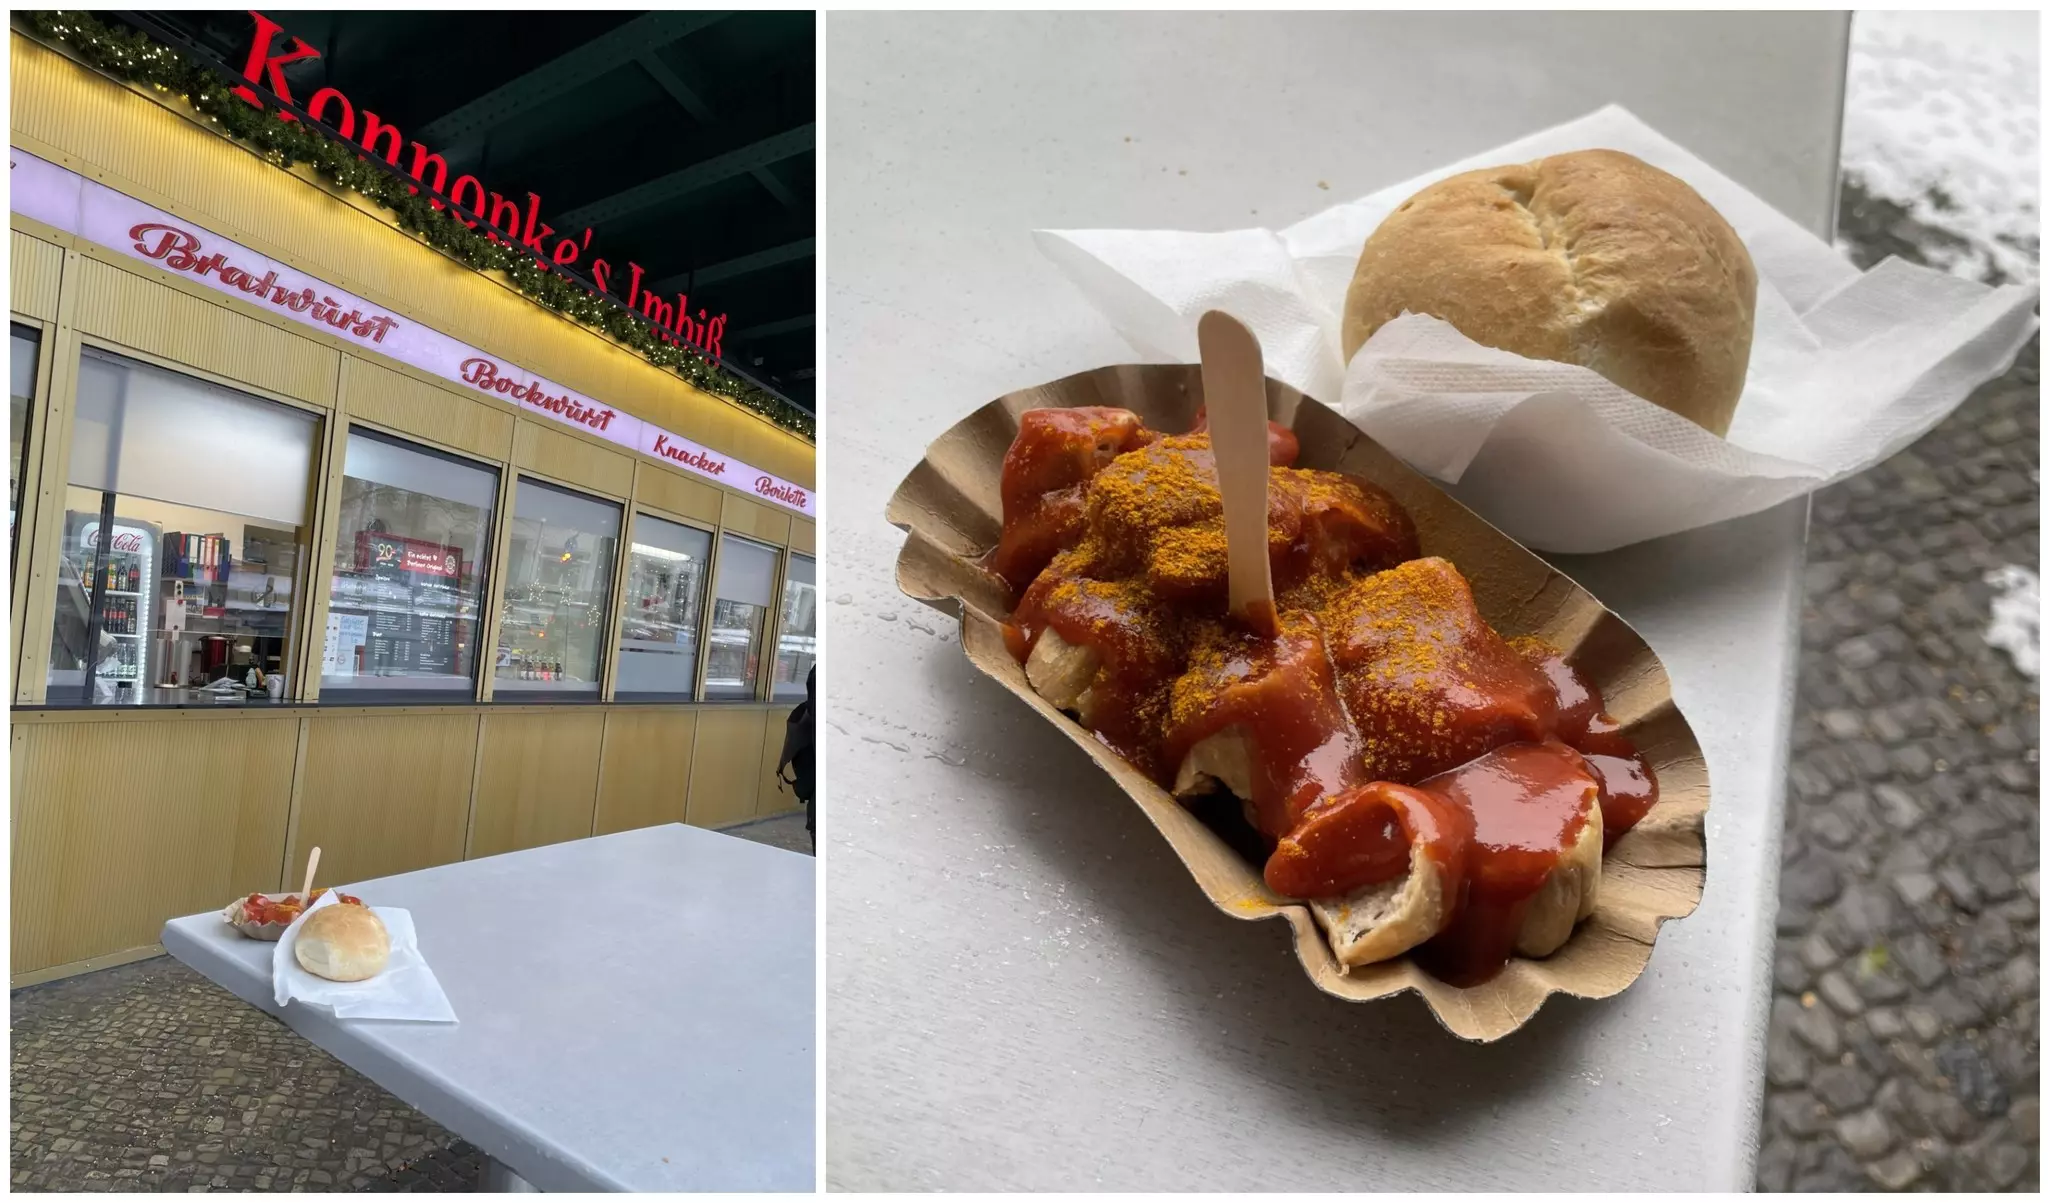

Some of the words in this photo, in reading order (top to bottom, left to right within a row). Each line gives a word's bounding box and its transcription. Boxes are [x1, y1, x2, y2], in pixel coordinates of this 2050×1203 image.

[230, 9, 610, 293] Konnopke's
[627, 261, 727, 368] Imbiß
[653, 434, 726, 475] Knacker
